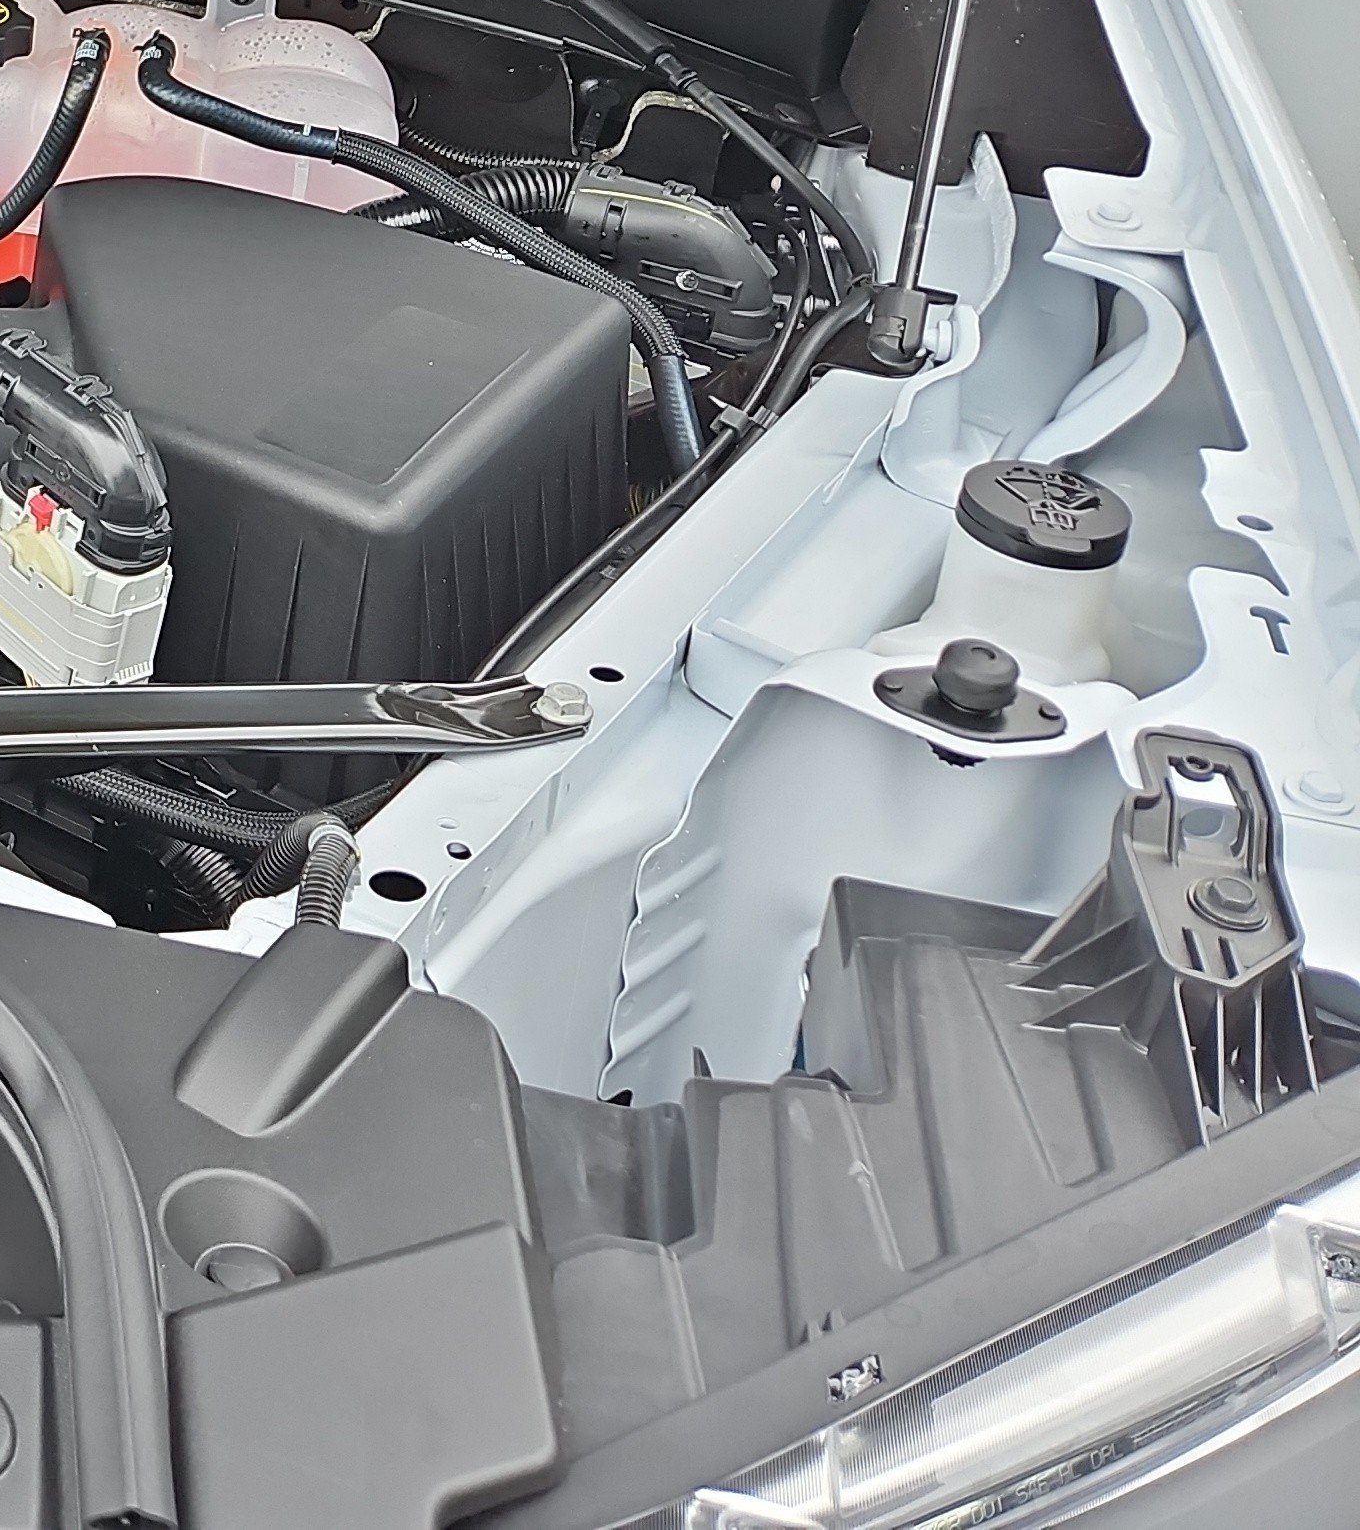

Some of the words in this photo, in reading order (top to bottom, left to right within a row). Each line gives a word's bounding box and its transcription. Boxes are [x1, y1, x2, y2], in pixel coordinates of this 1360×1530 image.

[971, 1496, 1003, 1524] DOT
[1016, 1474, 1049, 1504] SAE
[1059, 1461, 1082, 1485] HL
[1090, 1442, 1124, 1471] DPL
